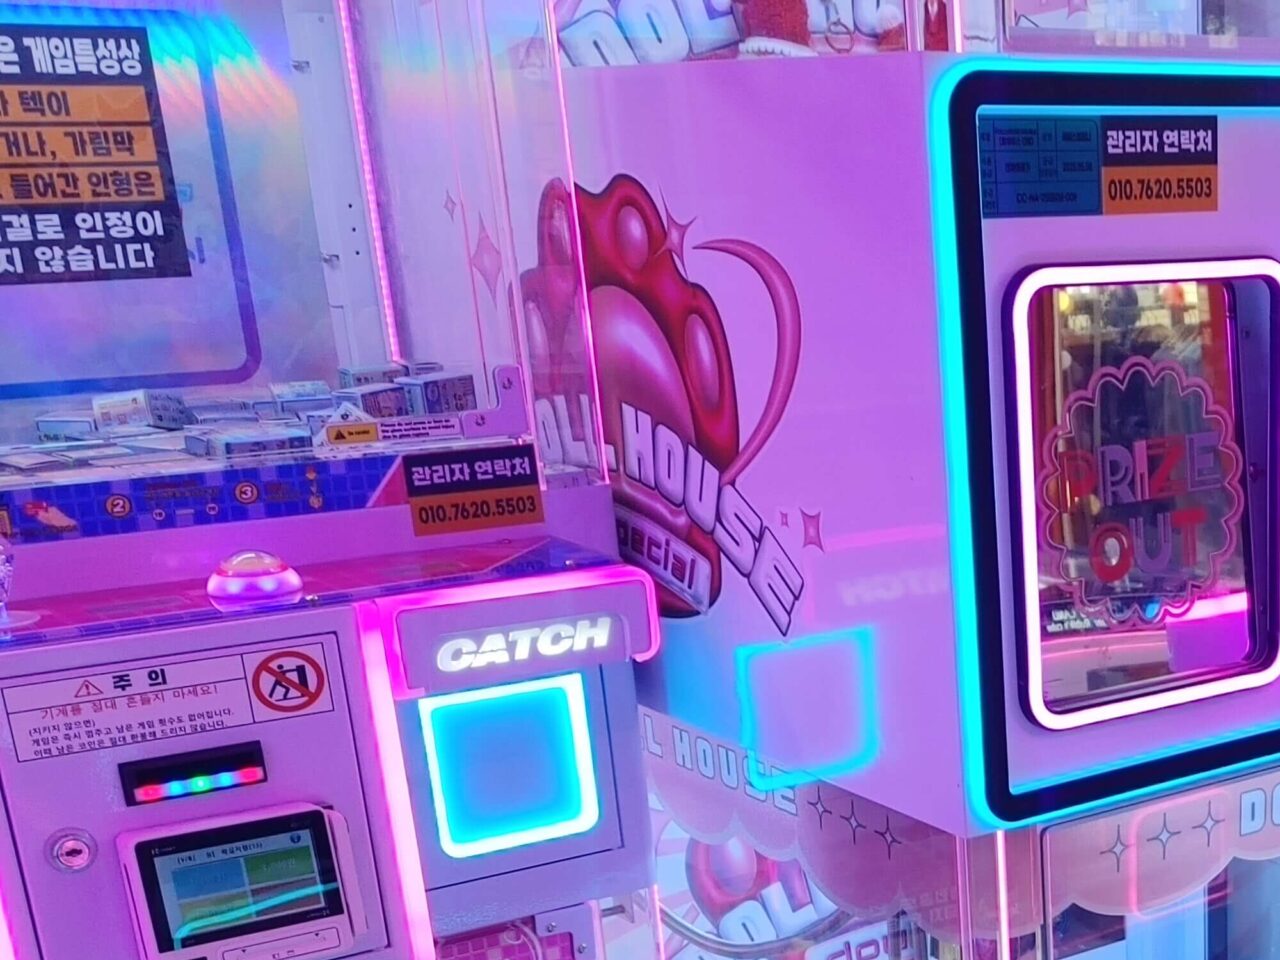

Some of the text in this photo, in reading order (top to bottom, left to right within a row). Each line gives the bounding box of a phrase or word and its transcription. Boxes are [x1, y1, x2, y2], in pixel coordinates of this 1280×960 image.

[22, 36, 142, 76] 게임특성상
[64, 131, 135, 156] 가림막
[1107, 130, 1212, 154] 관리자 연락처
[10, 171, 156, 199] 들어간 인형은
[1108, 177, 1212, 201] 010.7620.5503
[75, 210, 164, 239] 인정이
[34, 242, 155, 274] 않습니다
[411, 457, 531, 487] 관리자 연락처
[1059, 431, 1222, 512] PRIZE
[419, 496, 536, 524] 010.7620.5503
[621, 401, 804, 637] HOUSE
[616, 518, 696, 591] pecial
[1089, 506, 1208, 583] OUT
[437, 617, 612, 672] CATCH
[672, 726, 797, 816] HOUSE
